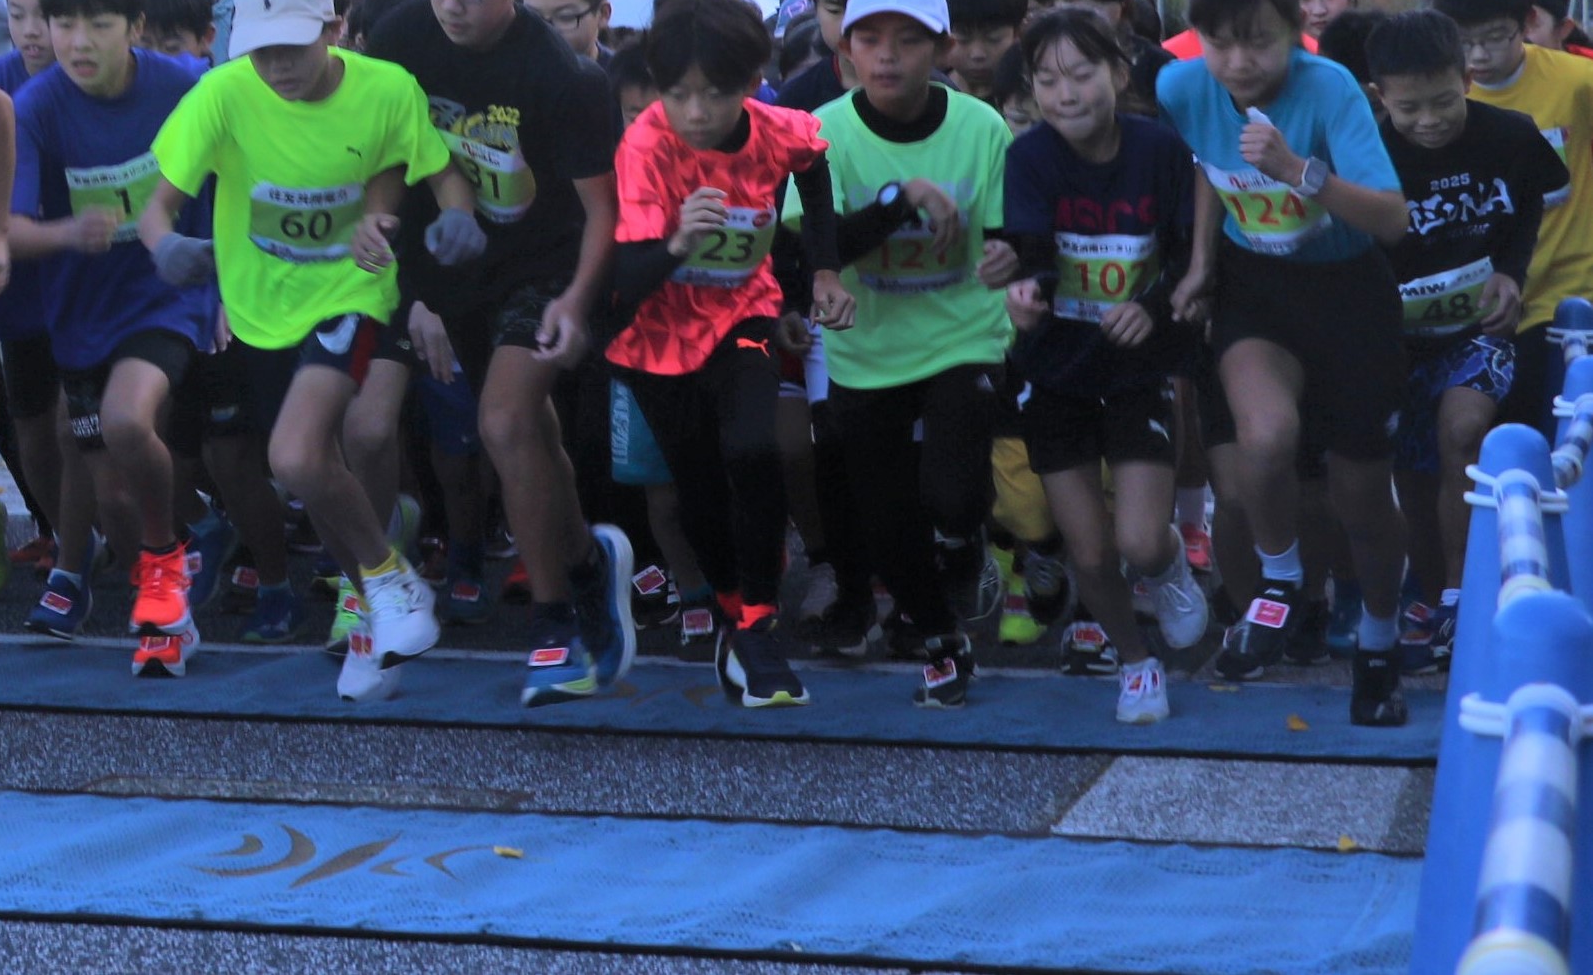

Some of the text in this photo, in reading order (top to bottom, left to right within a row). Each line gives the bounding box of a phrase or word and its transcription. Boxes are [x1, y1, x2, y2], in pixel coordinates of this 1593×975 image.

[1430, 173, 1471, 191] 2025
[1226, 192, 1306, 226] 124
[280, 209, 333, 242] 60
[700, 230, 756, 263] 23
[880, 240, 947, 270] 12
[1420, 292, 1474, 322] 48
